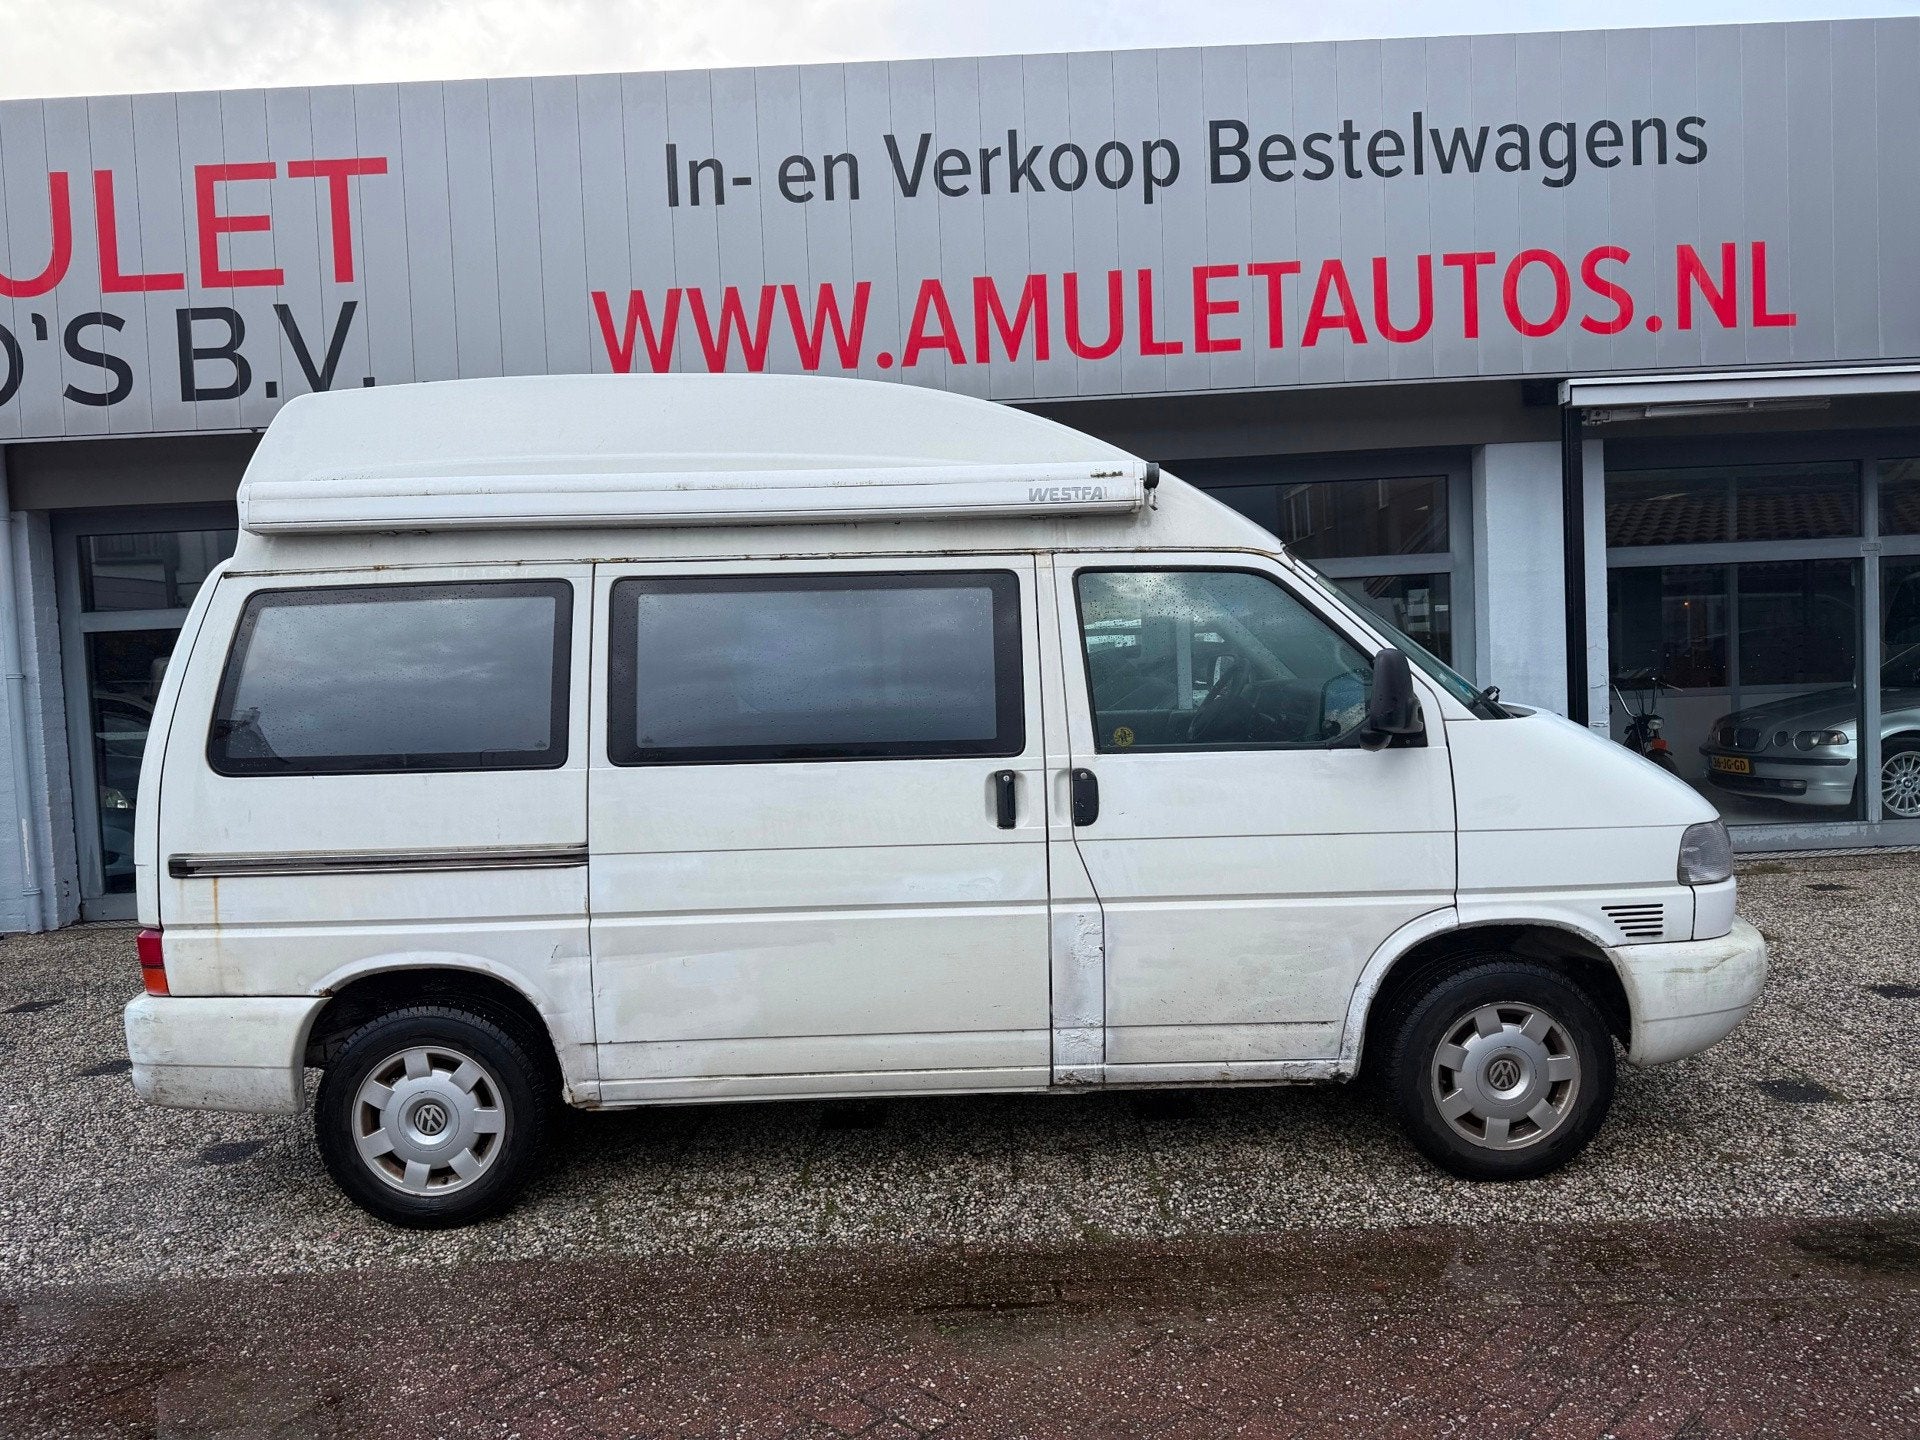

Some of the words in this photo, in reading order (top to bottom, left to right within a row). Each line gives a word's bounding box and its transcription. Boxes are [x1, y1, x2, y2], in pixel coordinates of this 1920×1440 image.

[666, 143, 752, 207] In-
[778, 152, 860, 204] en
[883, 129, 1181, 204] Verkoop
[1208, 111, 1708, 188] Bestelwagens
[176, 301, 376, 403] B.V.
[591, 240, 1798, 374] WWW.AMULETAUTOS.NL
